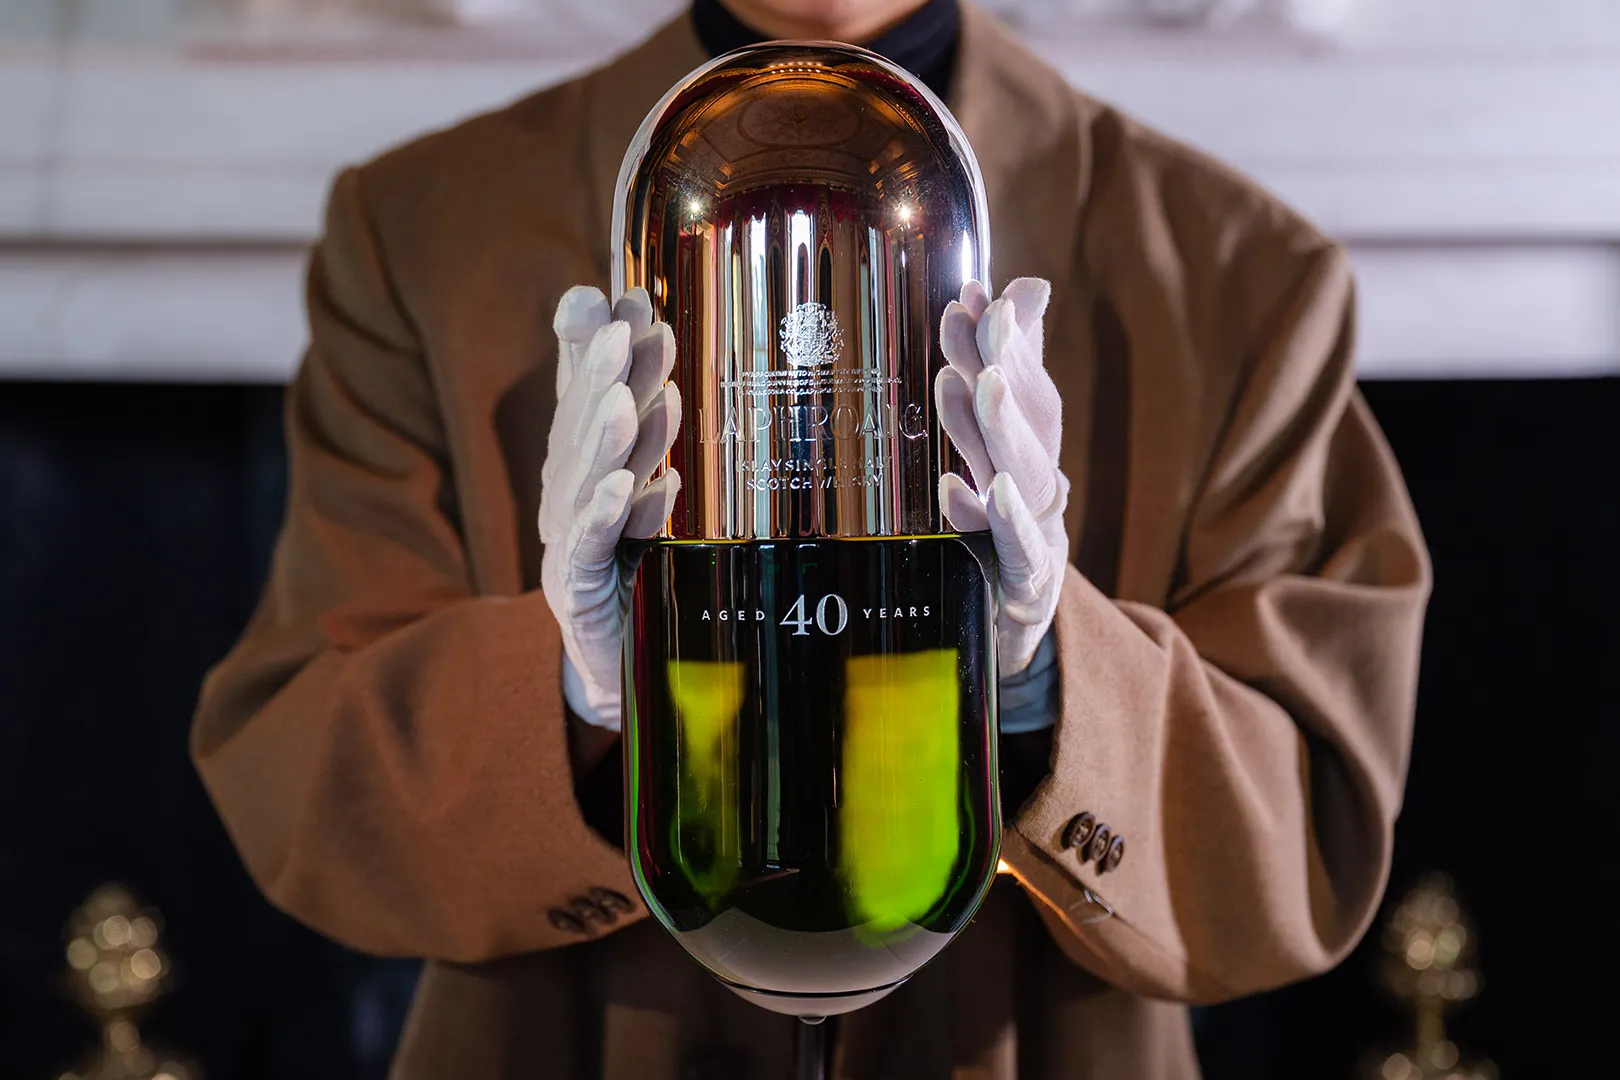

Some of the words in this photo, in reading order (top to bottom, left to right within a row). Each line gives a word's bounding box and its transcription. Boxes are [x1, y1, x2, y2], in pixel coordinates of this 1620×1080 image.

[698, 402, 929, 444] LAPHROAIG
[746, 477, 813, 491] SCOTCH
[701, 608, 765, 621] AGED
[779, 593, 849, 636] 40
[862, 605, 930, 619] YEARS
